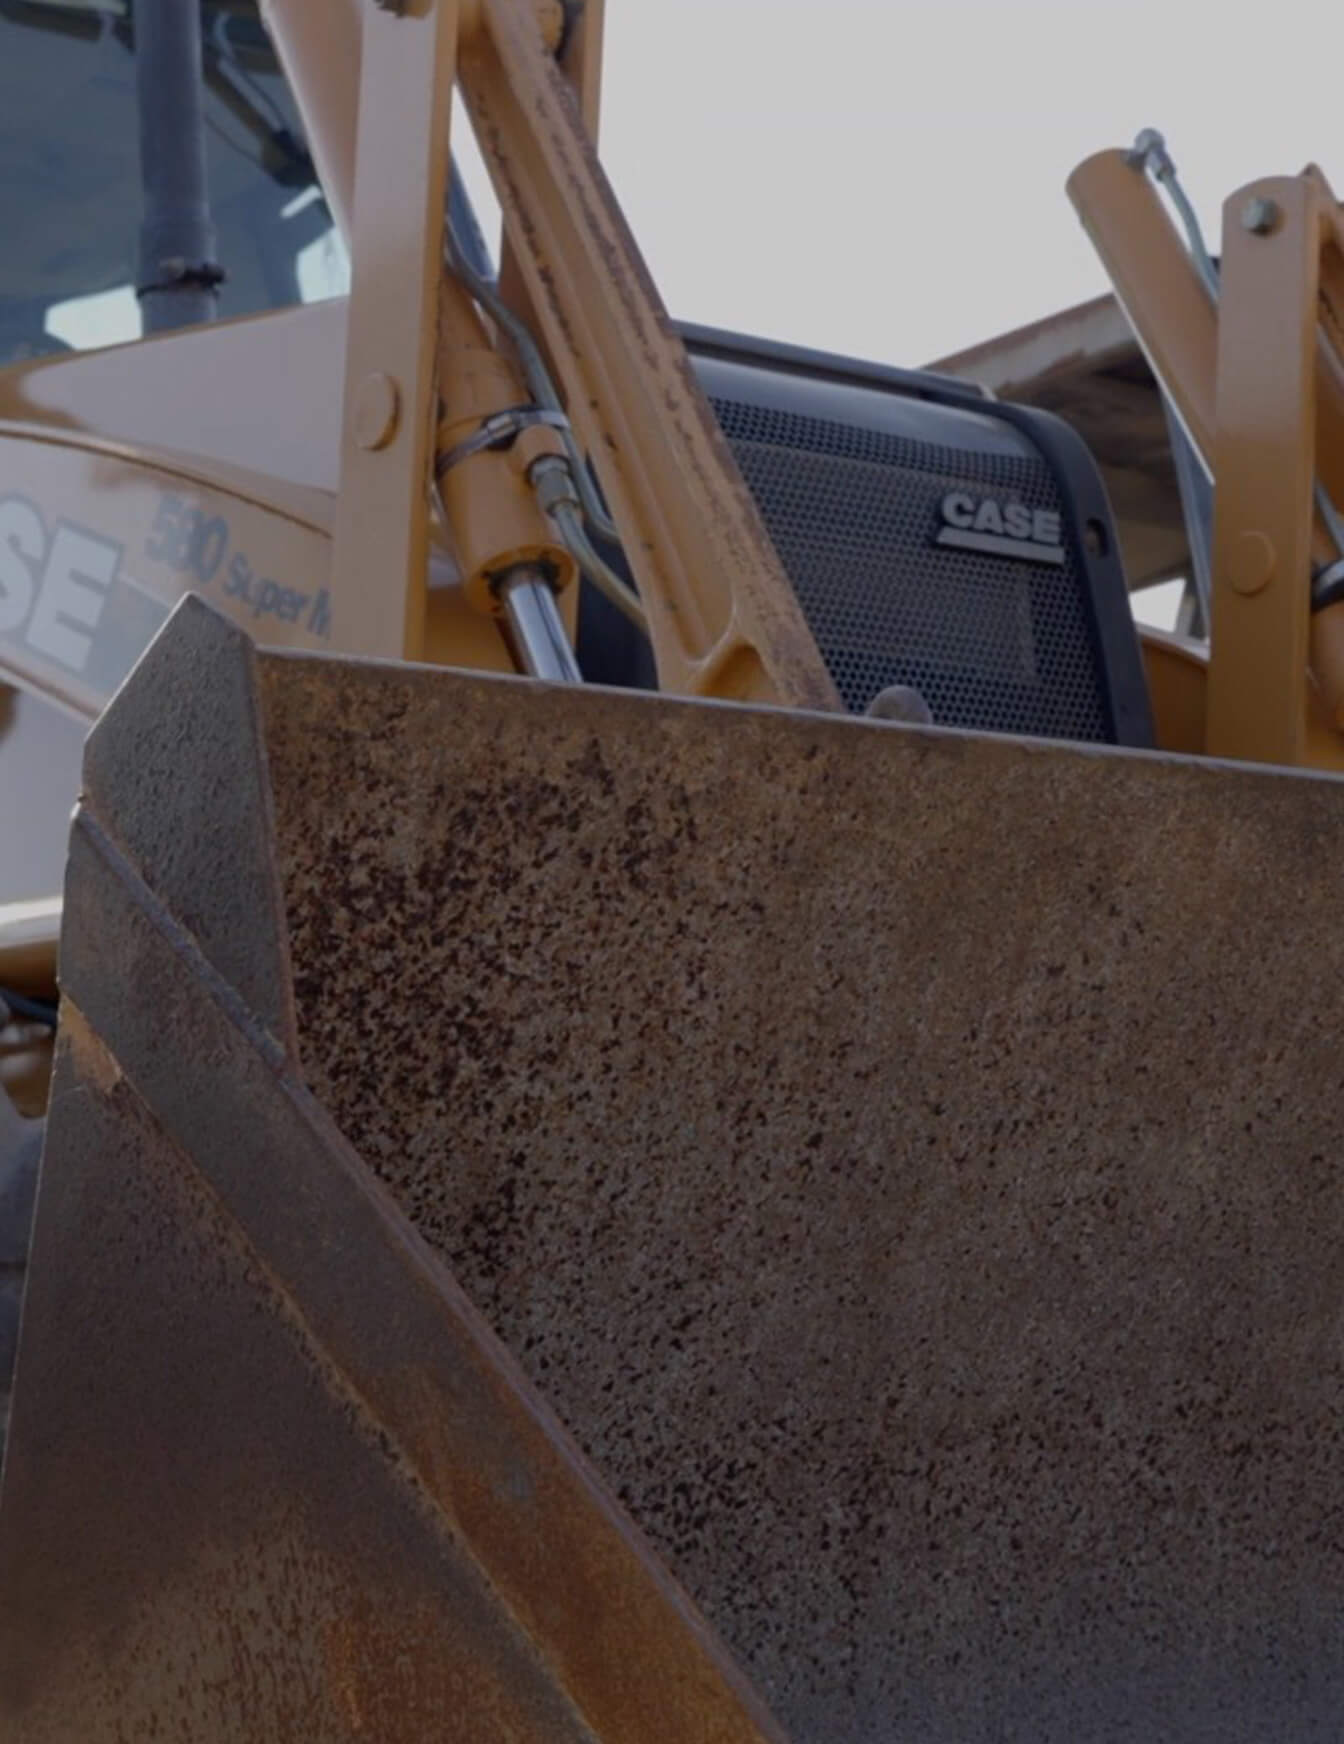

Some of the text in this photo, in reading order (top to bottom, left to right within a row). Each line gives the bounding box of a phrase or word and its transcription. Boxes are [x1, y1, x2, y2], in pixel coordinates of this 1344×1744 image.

[146, 494, 227, 581] 580
[223, 552, 310, 624] Super
[941, 492, 1061, 544] CASE
